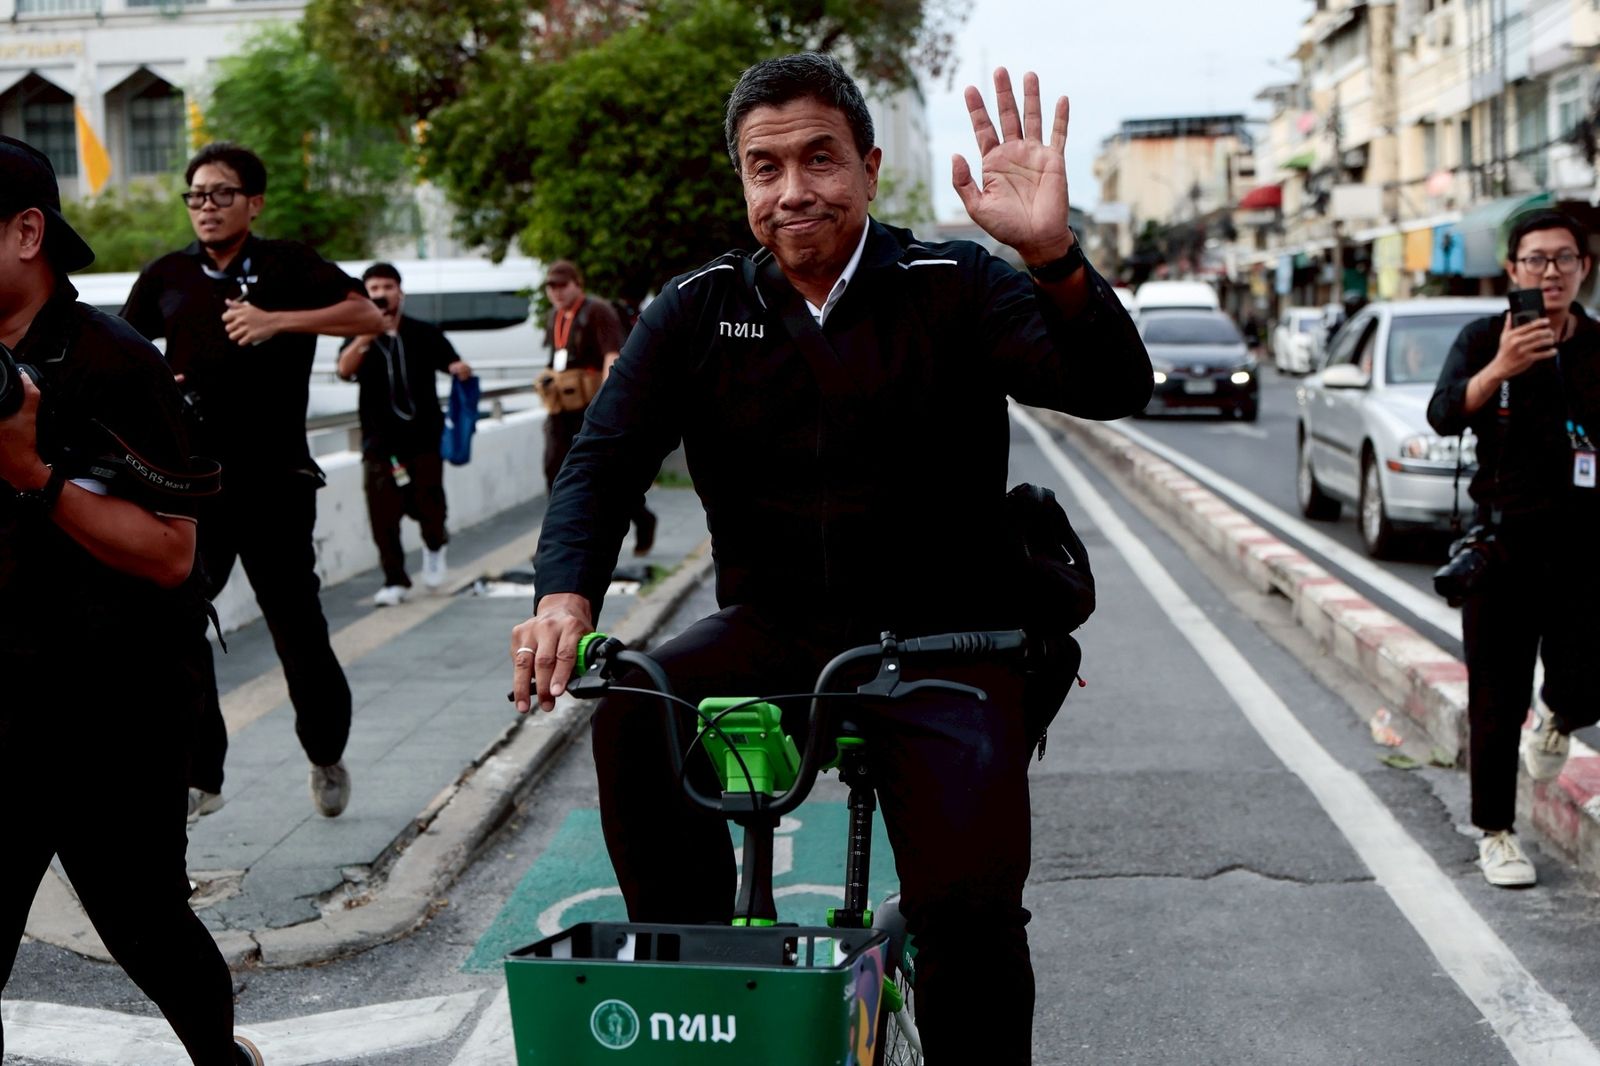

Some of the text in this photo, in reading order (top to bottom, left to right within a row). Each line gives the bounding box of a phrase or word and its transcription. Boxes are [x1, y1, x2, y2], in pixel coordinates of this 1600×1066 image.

[720, 321, 764, 338] กทม
[126, 454, 148, 476] EOS
[149, 472, 165, 483] R5
[164, 480, 185, 490] Mark
[650, 1013, 736, 1043] กทม
